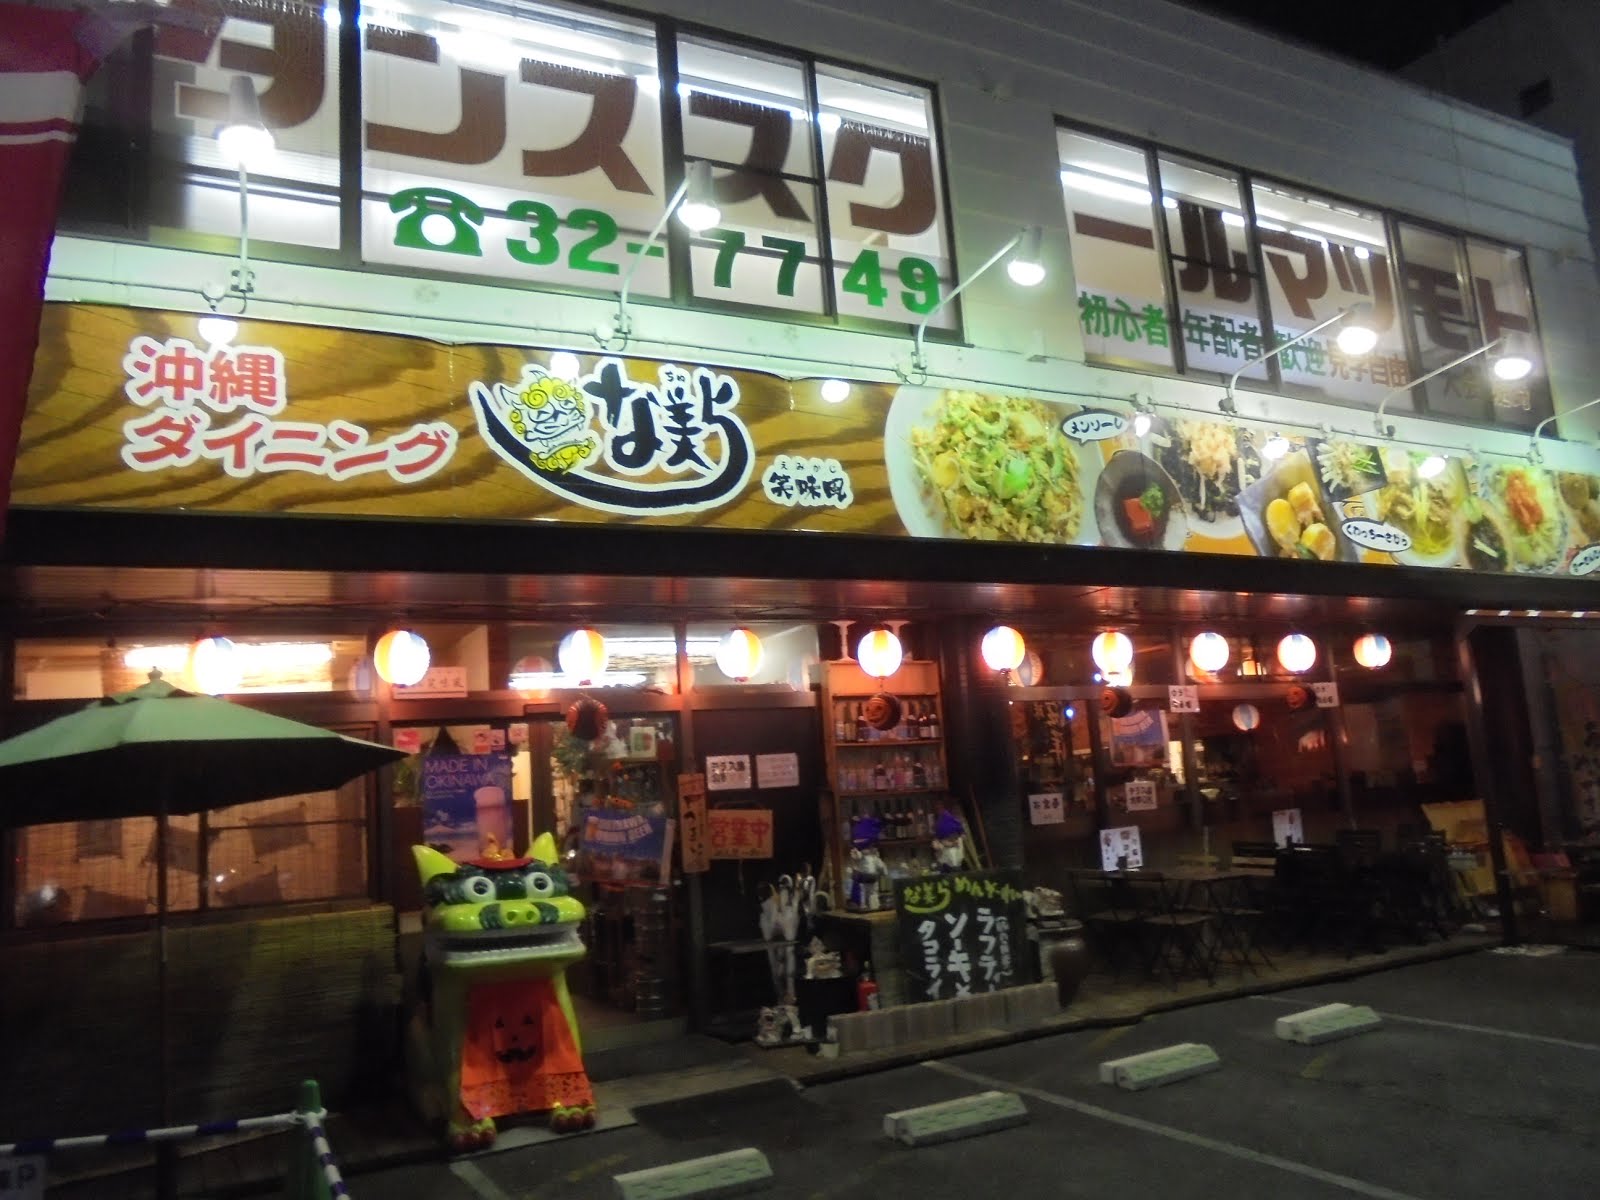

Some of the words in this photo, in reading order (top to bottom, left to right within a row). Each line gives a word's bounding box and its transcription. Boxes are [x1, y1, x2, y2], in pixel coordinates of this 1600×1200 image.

[1078, 291, 1168, 347] 初心者
[1183, 309, 1264, 361] 年配者
[133, 344, 278, 407] 沖縄
[131, 414, 450, 476] ダイニング
[424, 758, 469, 773] MADE
[472, 757, 489, 771] IN
[709, 816, 770, 849] 営業中
